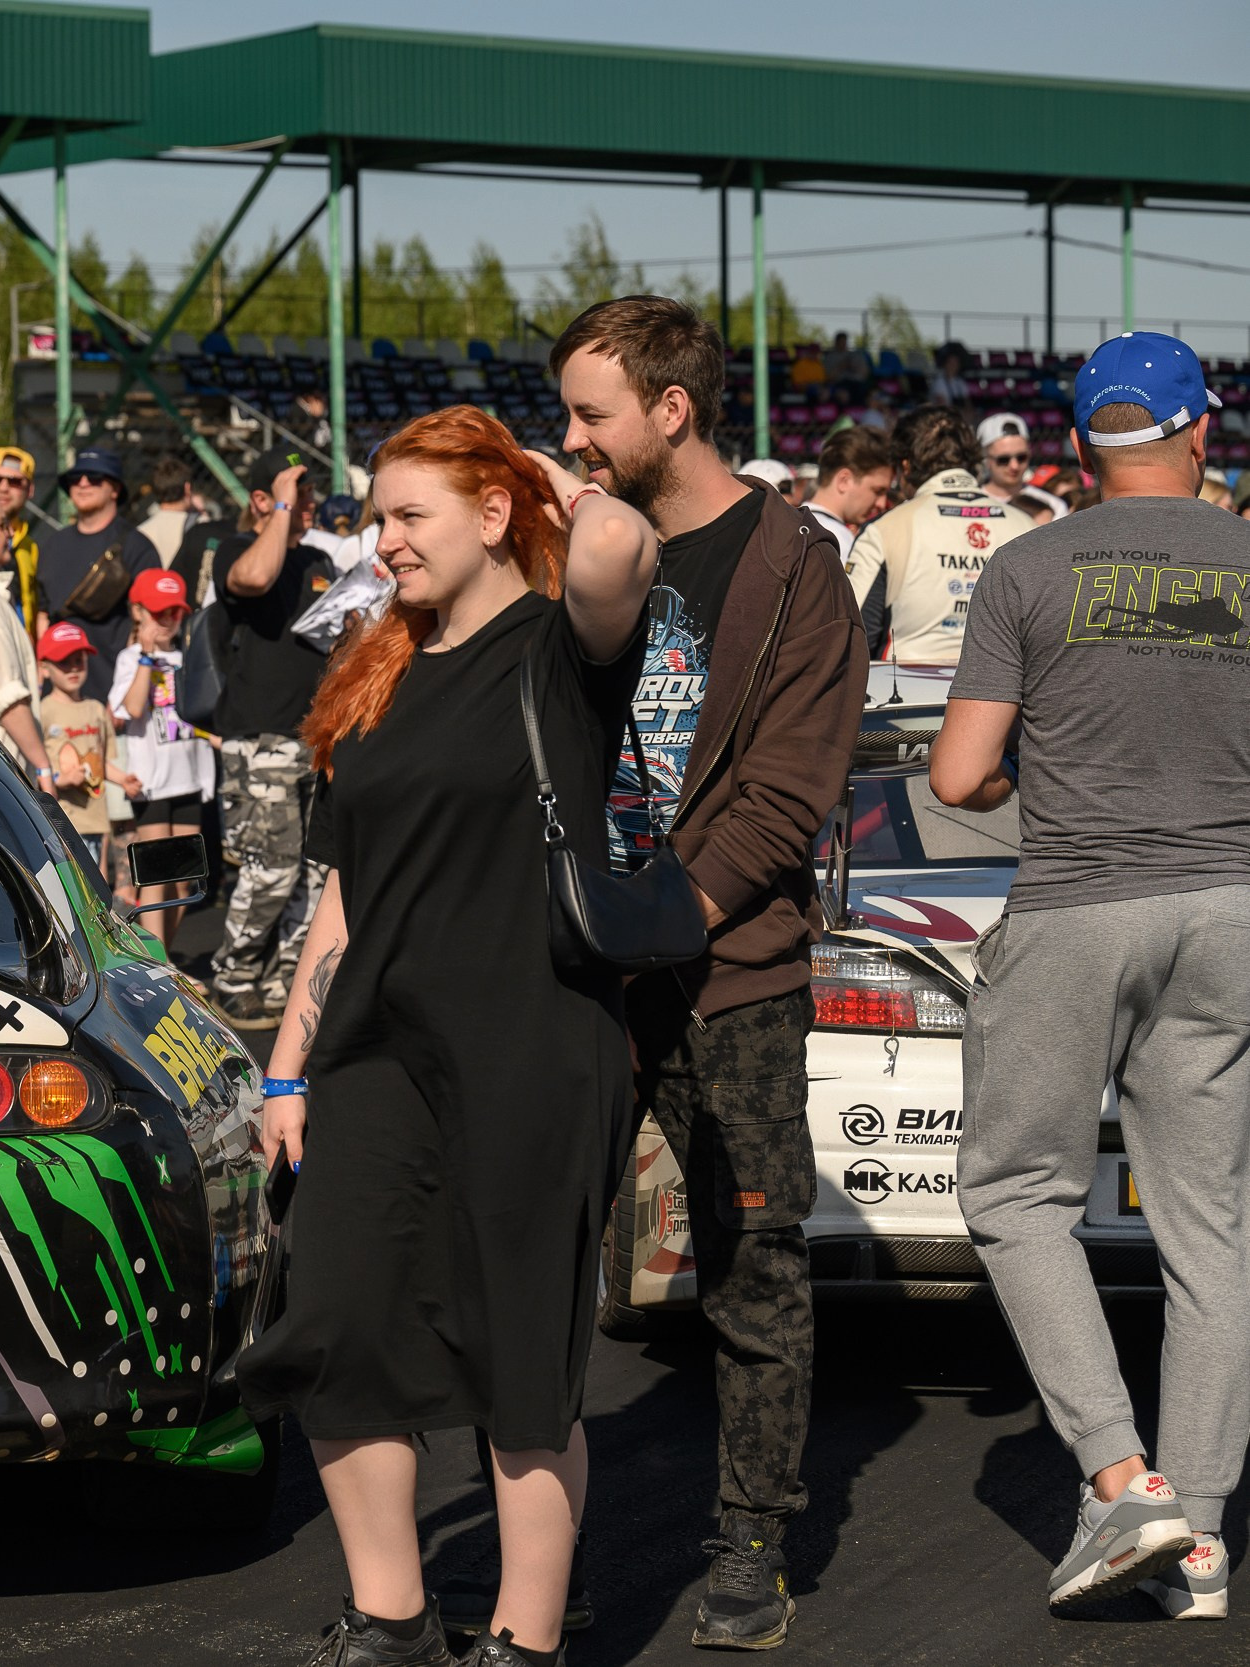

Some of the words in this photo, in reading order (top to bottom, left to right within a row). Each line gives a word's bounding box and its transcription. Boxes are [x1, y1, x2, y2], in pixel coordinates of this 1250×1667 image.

[1072, 551, 1113, 562] RUN
[1120, 550, 1171, 562] YOUR
[1127, 645, 1165, 656] NOT
[1170, 648, 1214, 661] YOUR
[843, 1170, 895, 1192] MK
[1148, 1476, 1164, 1485] NIKE
[1191, 1547, 1211, 1556] NIKE
